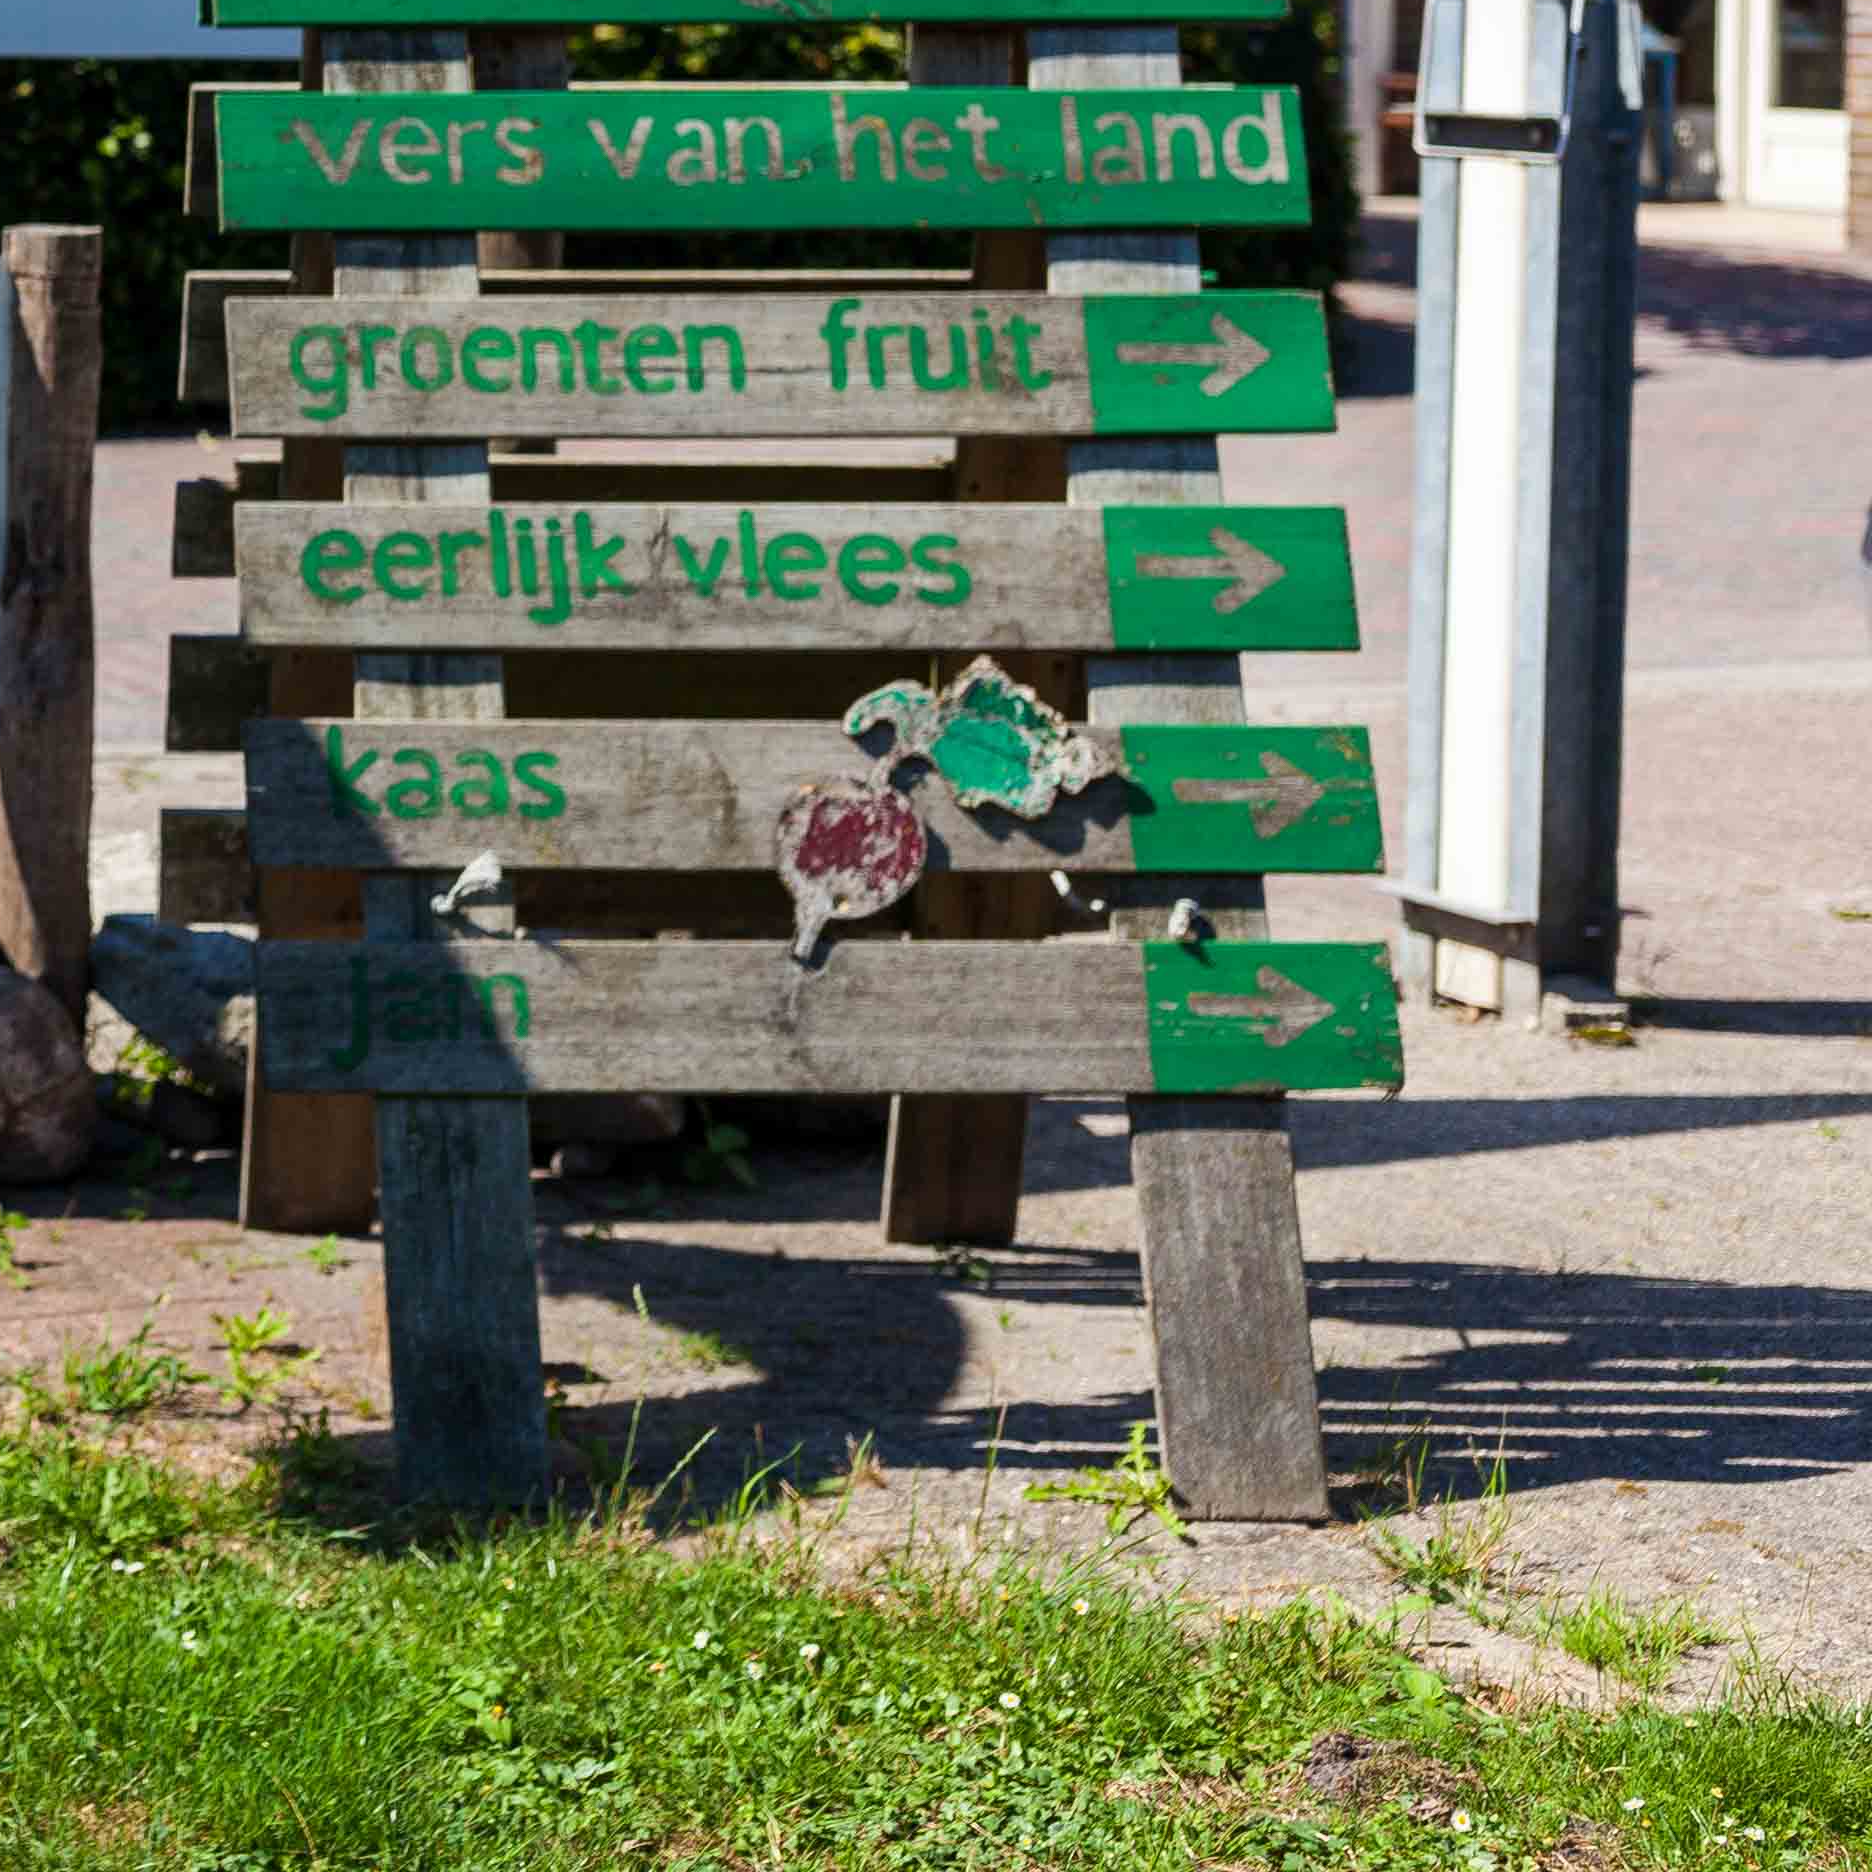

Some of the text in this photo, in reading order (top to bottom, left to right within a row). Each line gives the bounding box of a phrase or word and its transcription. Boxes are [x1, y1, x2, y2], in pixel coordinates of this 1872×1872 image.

[288, 91, 1289, 186] vers van het land
[289, 299, 1053, 421] groenten fruit
[301, 510, 972, 625] eerlijk vlees
[326, 725, 567, 820] kaas
[333, 957, 531, 1072] jam
